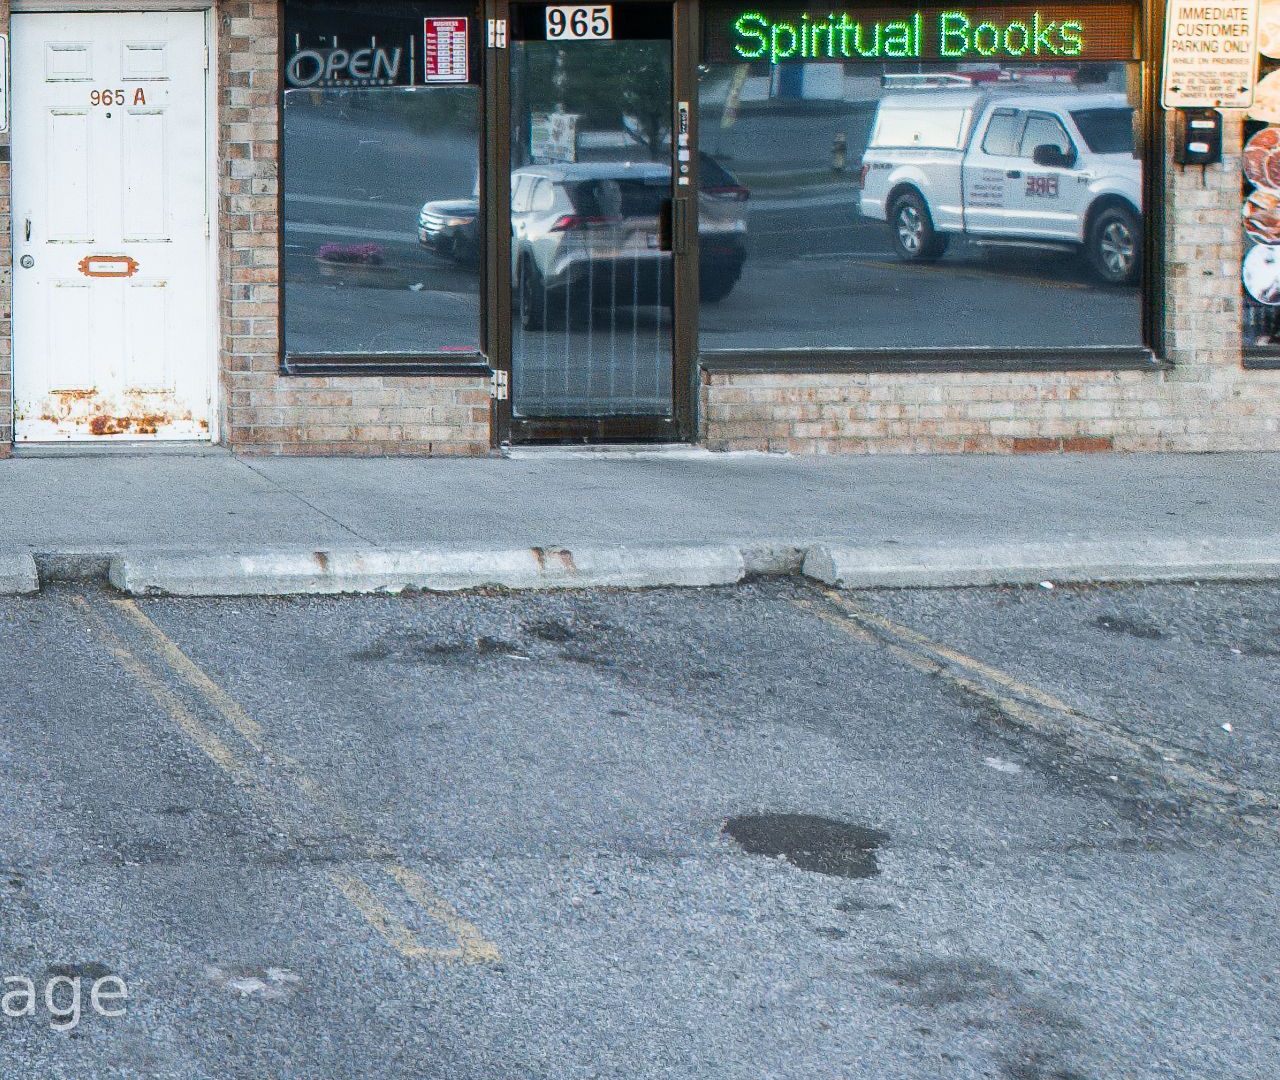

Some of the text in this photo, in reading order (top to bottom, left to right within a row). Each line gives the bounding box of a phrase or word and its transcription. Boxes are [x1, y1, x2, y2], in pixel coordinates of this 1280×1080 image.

[549, 8, 610, 38] 965
[1179, 7, 1249, 21] IMMEDIATE
[734, 11, 1084, 64] Spiritual Books
[1177, 23, 1250, 37] CUSTOMER
[1172, 40, 1251, 53] PARKING ONLY
[286, 47, 401, 87] OPEN
[89, 89, 147, 107] 965 A
